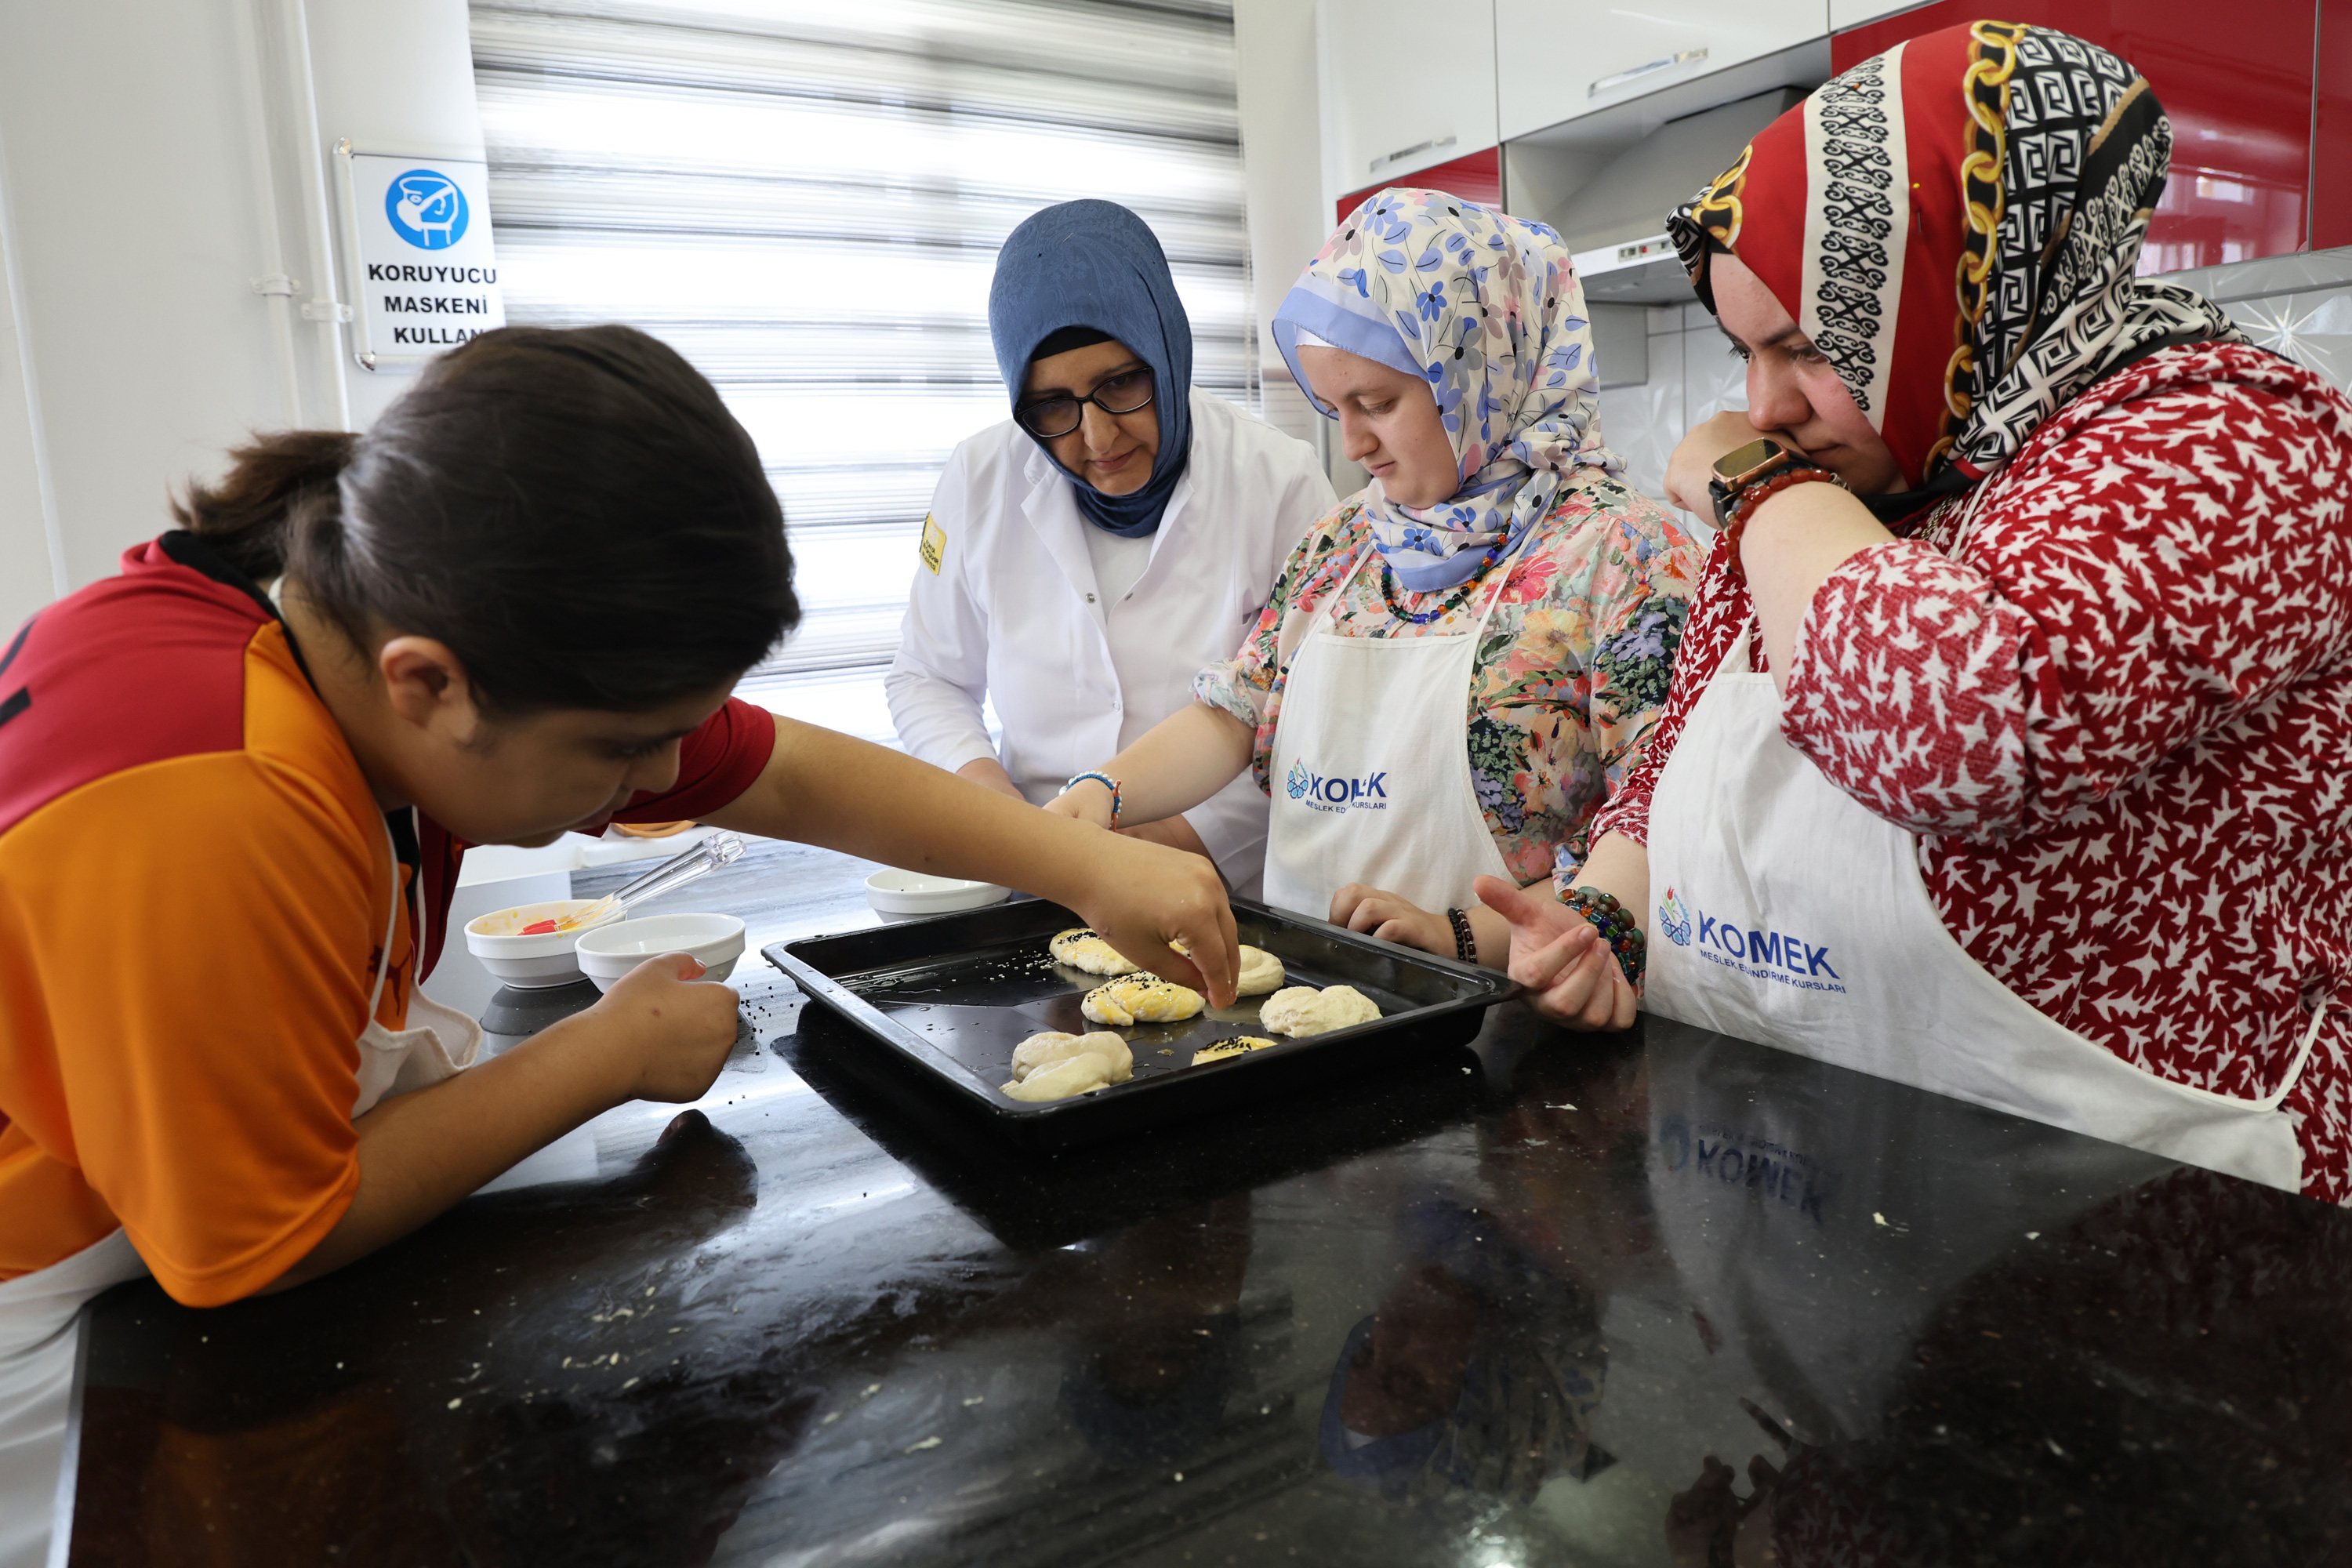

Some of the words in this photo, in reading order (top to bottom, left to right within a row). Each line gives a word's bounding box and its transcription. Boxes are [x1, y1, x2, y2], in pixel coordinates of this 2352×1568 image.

[368, 263, 497, 284] KORUYUCU
[384, 295, 488, 314] MASKENİ
[1305, 799, 1334, 812] MESLEK
[1698, 909, 1841, 980] KOMEK
[1700, 949, 1737, 970] MESLEK
[1791, 978, 1846, 994] KURSLARI
